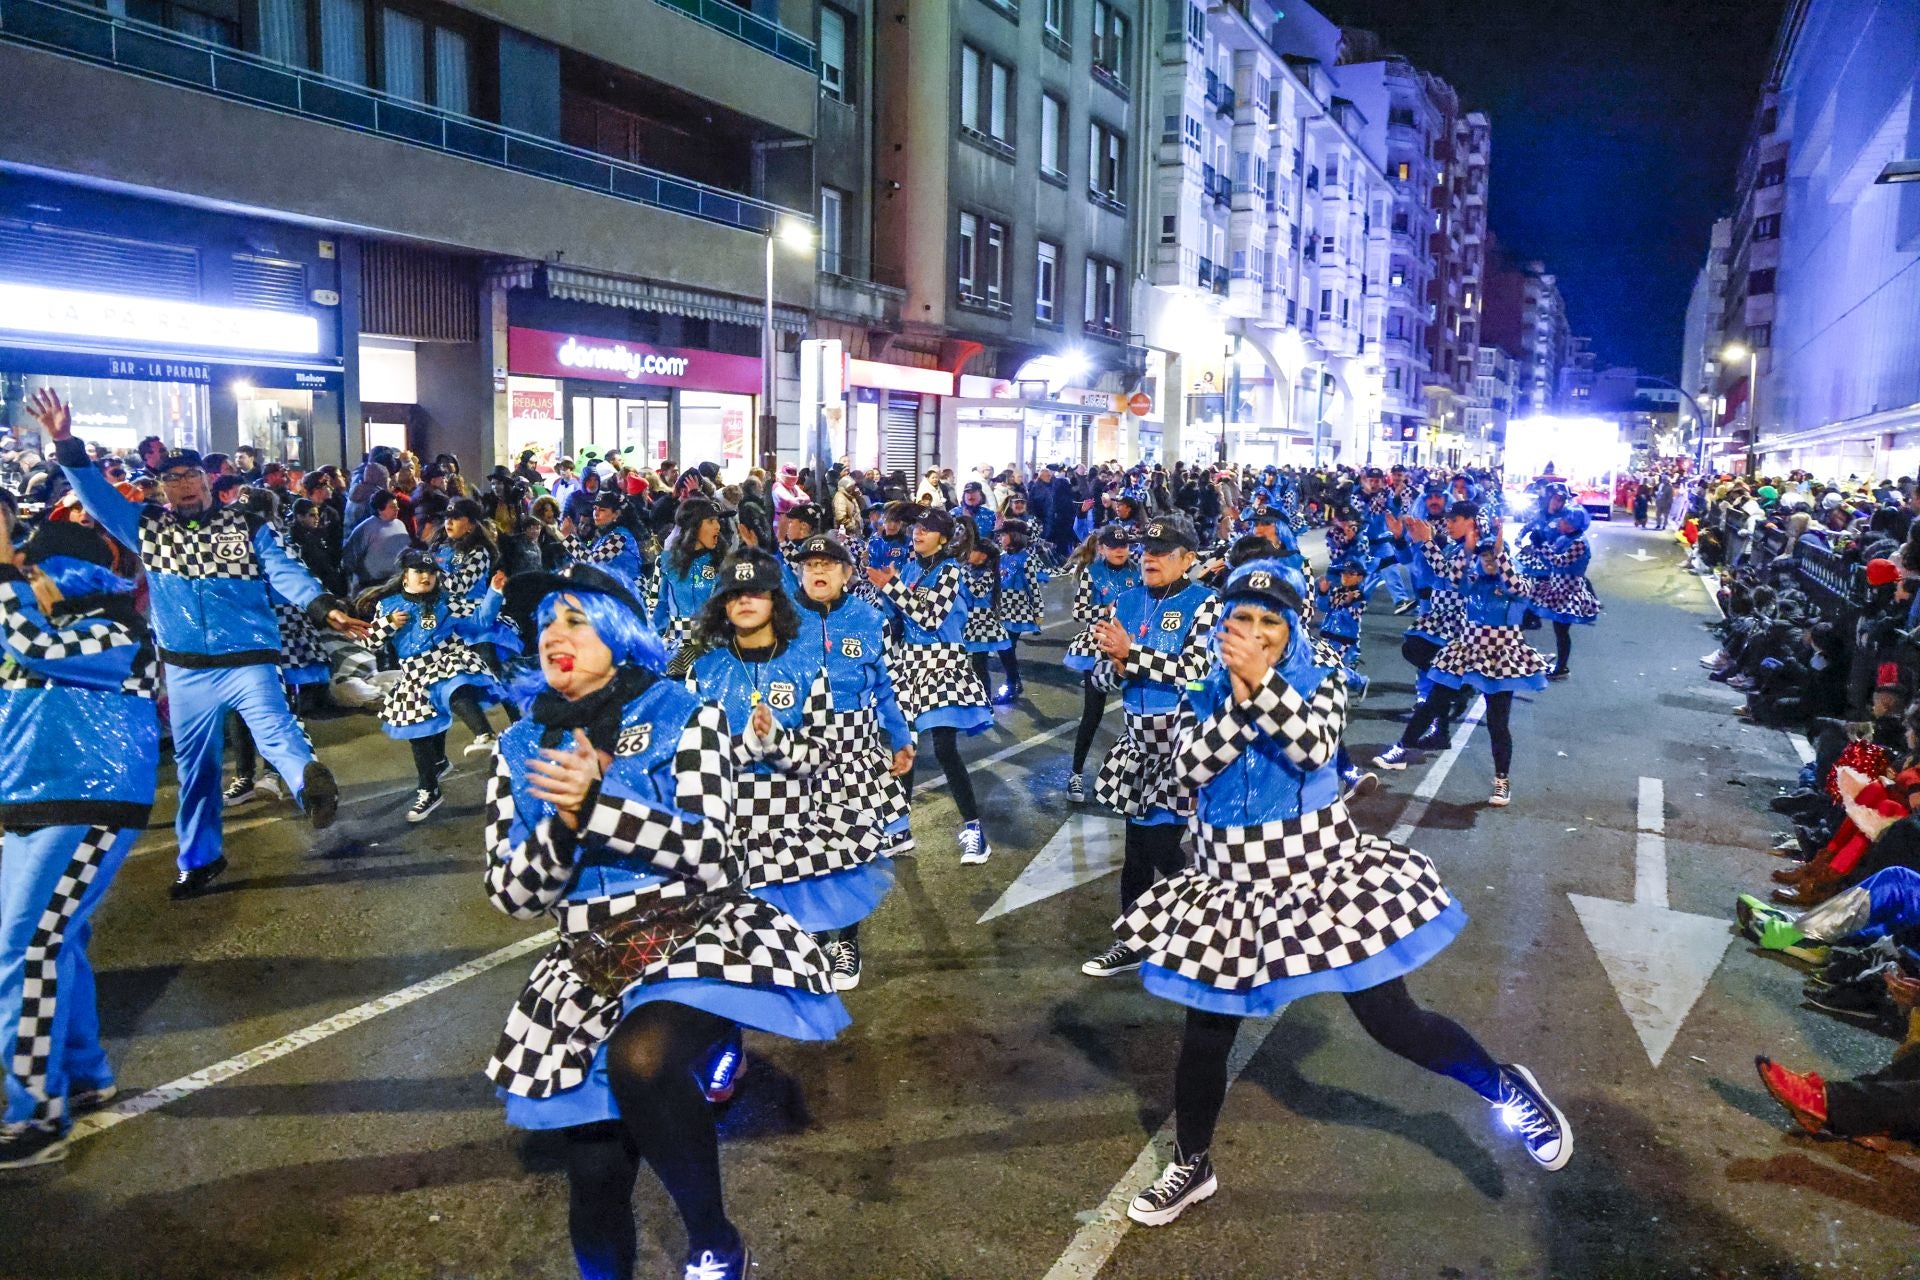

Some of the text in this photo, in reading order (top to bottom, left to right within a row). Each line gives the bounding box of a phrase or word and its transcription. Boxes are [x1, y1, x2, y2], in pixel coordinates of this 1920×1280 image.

[558, 336, 687, 379] dormity.com
[112, 361, 135, 374] BAR
[149, 363, 162, 376] LA
[166, 365, 208, 379] PARADA
[513, 397, 553, 409] REBAJAS
[221, 543, 244, 557] 66
[703, 570, 714, 579] 66
[738, 570, 751, 580] 66
[1252, 579, 1267, 588] 66
[423, 620, 435, 629] 66
[1162, 619, 1178, 629] 66
[845, 645, 861, 657] 66
[771, 692, 791, 706] 66
[616, 734, 644, 754] 66
